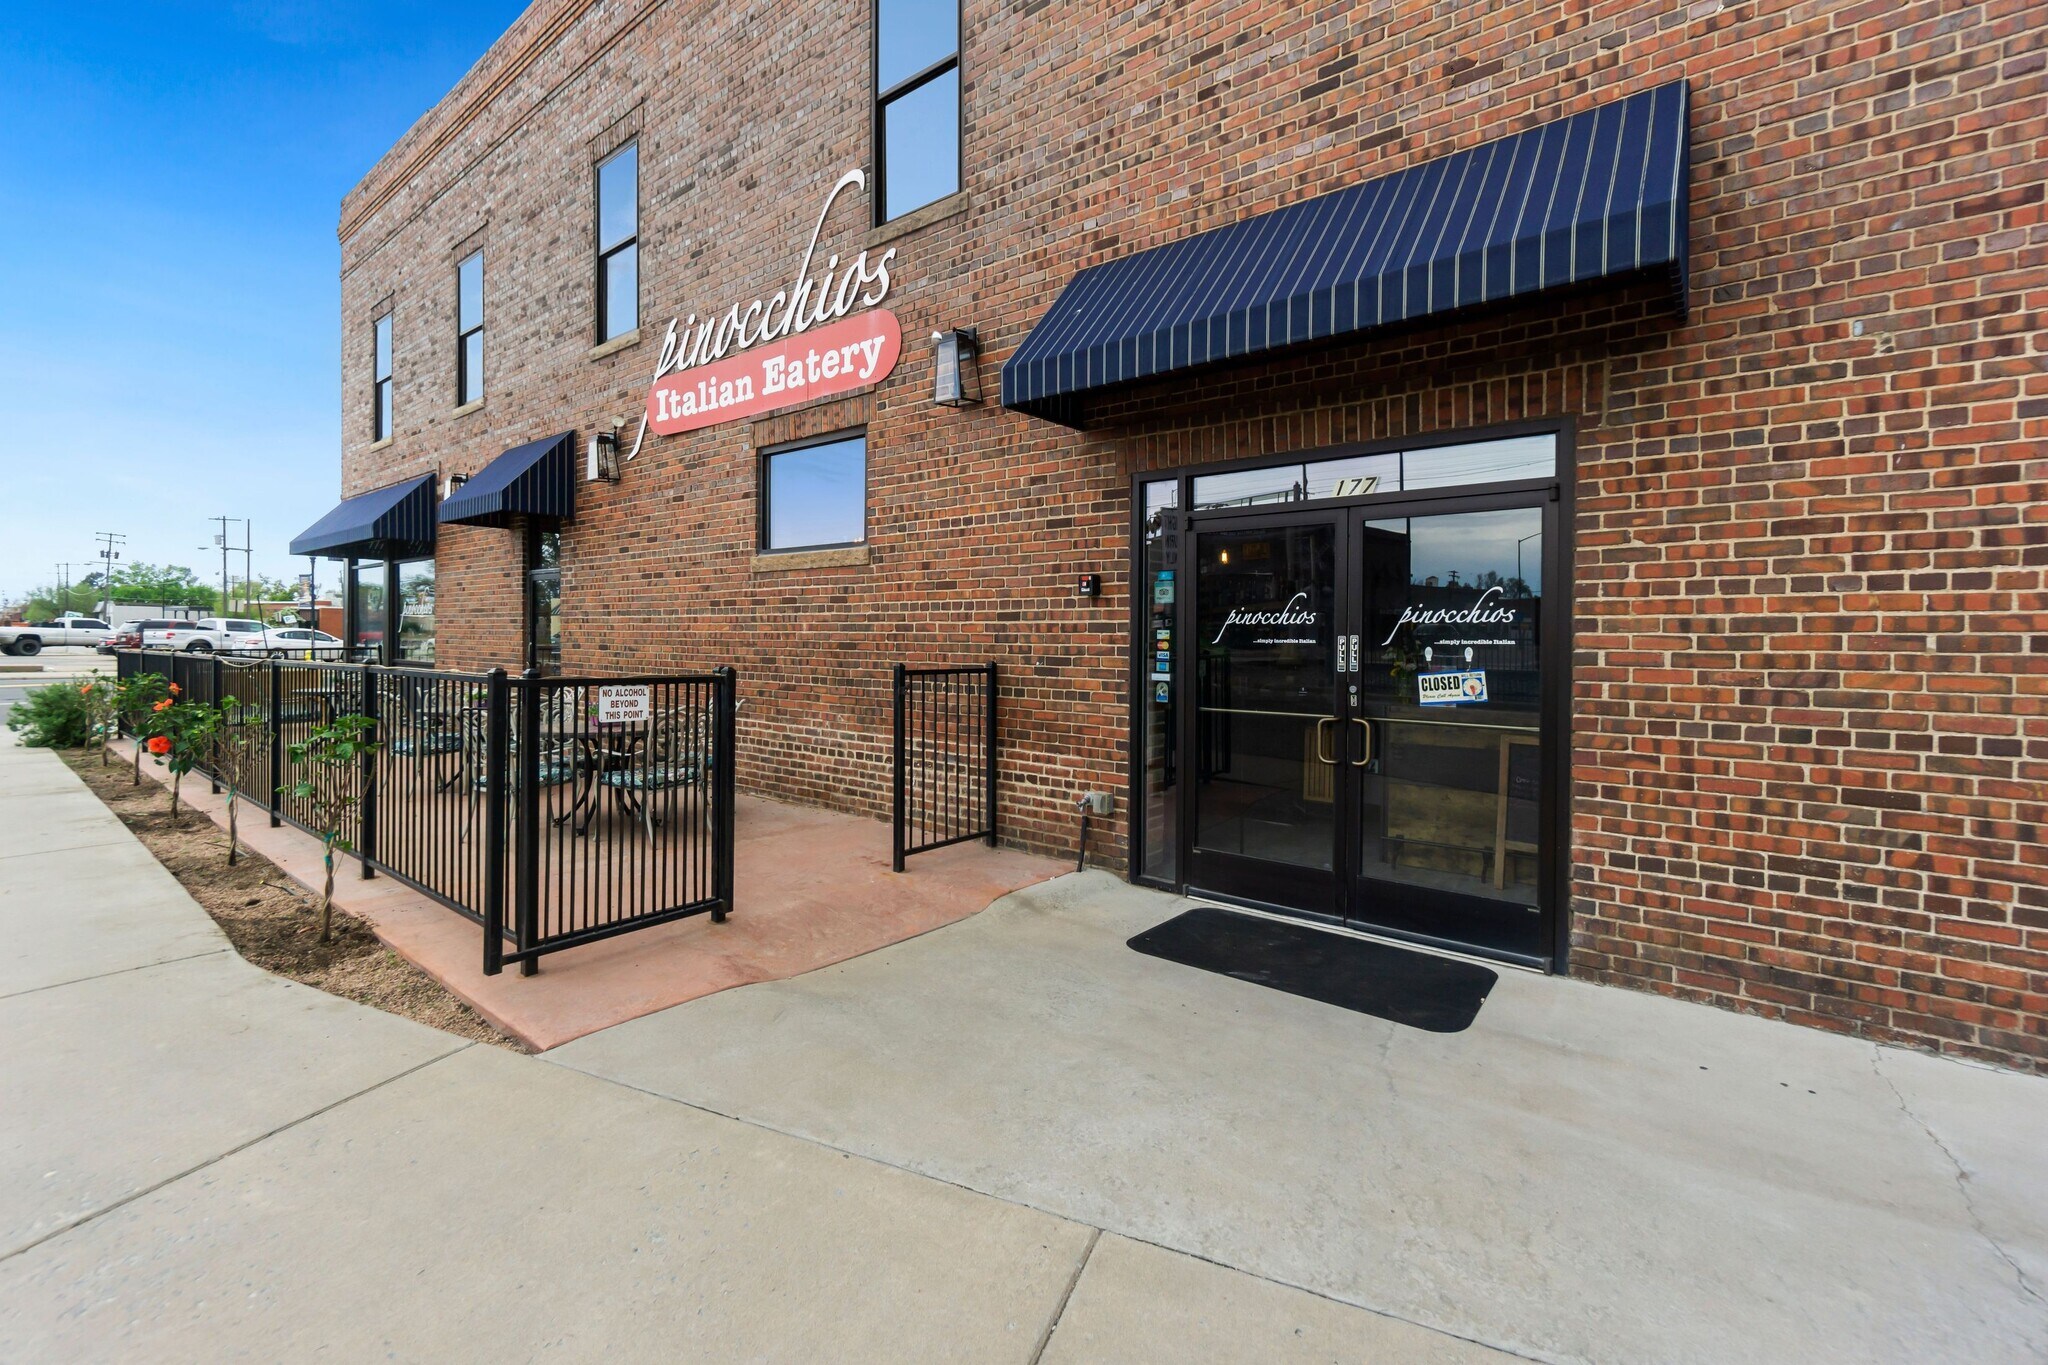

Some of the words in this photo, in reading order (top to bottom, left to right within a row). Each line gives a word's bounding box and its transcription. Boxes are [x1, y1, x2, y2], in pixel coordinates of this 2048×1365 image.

[627, 168, 897, 461] pinocchios
[655, 375, 754, 423] Italian
[762, 335, 885, 396] Eatery
[1336, 476, 1378, 496] 177
[1211, 592, 1317, 645] pinocchios
[1381, 586, 1516, 646] pinocchios
[602, 689, 612, 697] NO
[615, 688, 646, 697] ALCOHOL
[1421, 675, 1460, 691] CLOSED
[610, 700, 638, 708] BEYOND
[605, 711, 620, 720] THIS
[623, 710, 644, 719] POINT
